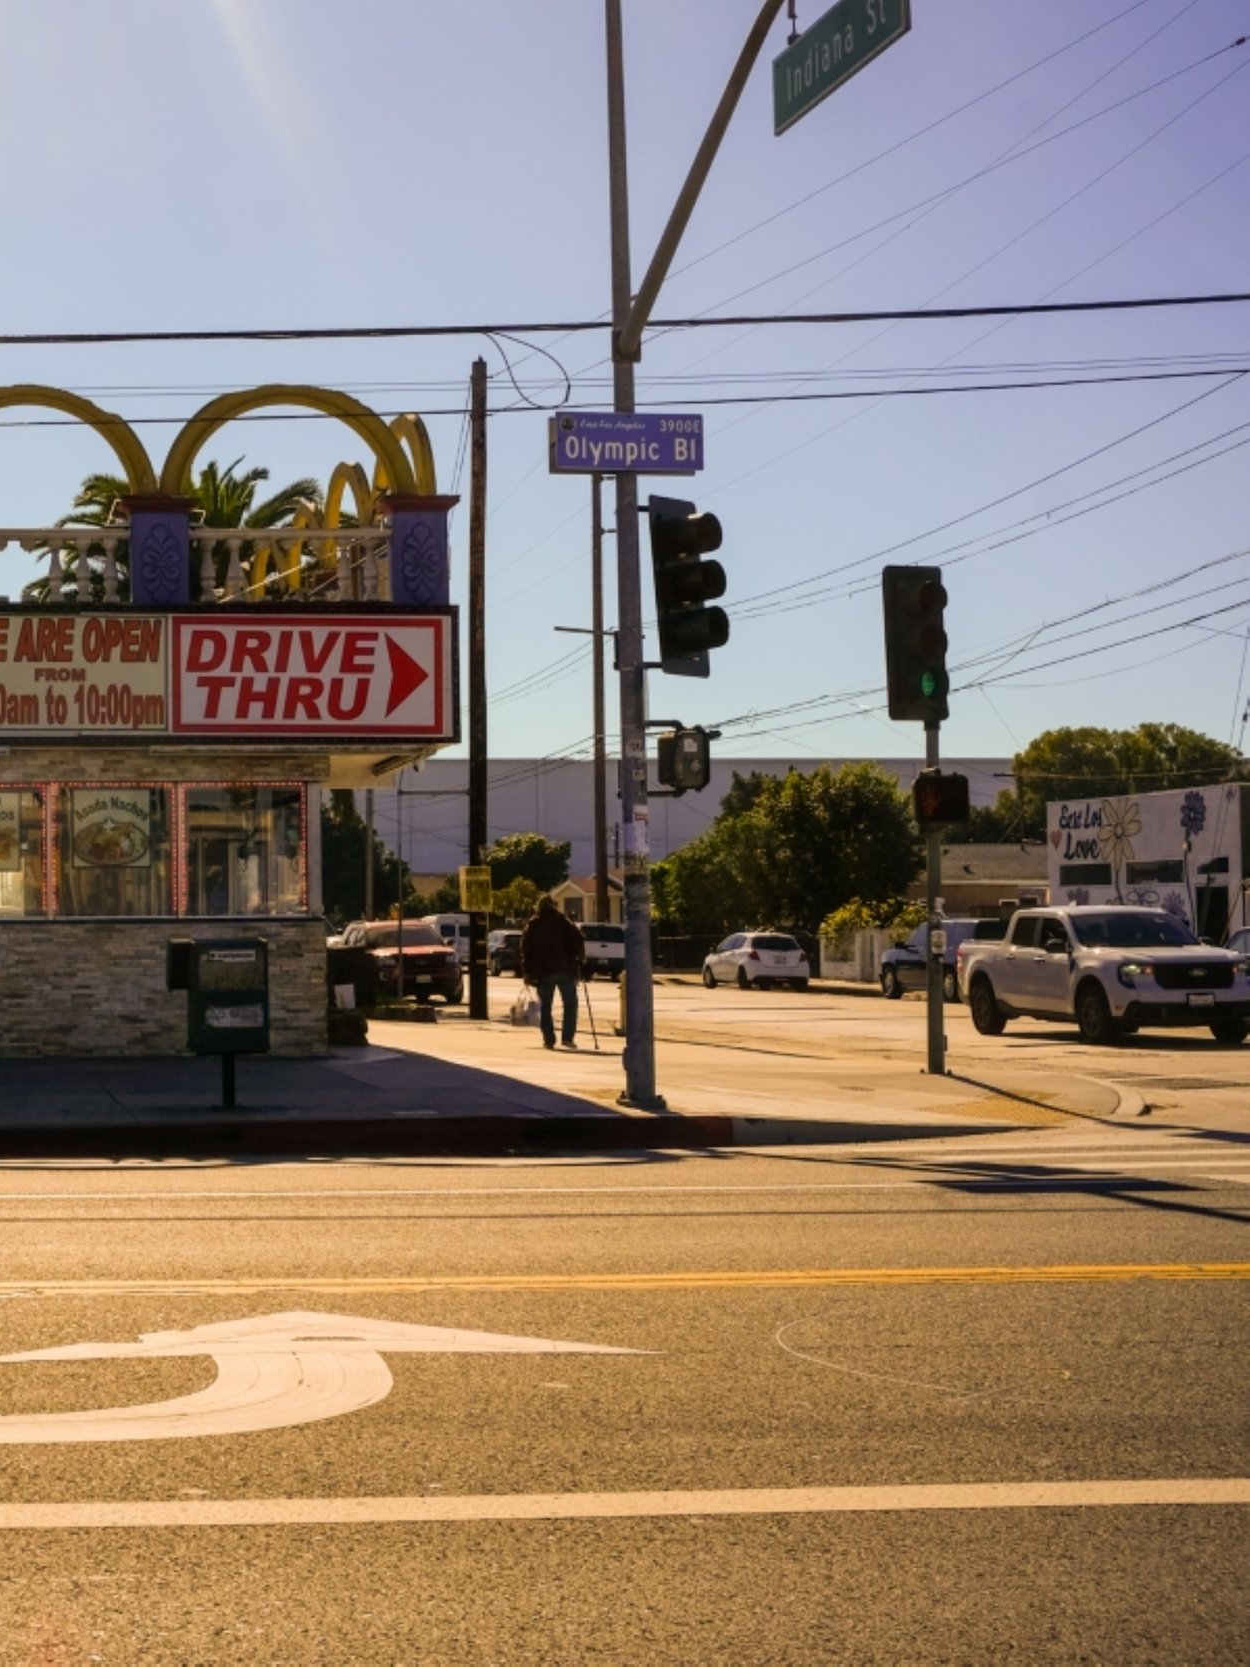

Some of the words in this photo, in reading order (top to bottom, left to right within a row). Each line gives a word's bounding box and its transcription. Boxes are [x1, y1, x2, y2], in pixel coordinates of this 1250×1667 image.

[786, 23, 854, 103] Indiana
[565, 436, 660, 466] Olympic
[674, 438, 696, 461] Bl
[14, 618, 75, 662] ARE
[82, 617, 162, 663] OPEN
[185, 630, 379, 673] DRIVE
[34, 668, 86, 682] FROM
[45, 686, 68, 725] to
[74, 684, 164, 729] 10:00pm
[196, 676, 370, 721] THRU
[76, 799, 108, 821] Asada
[111, 797, 149, 821] Nachos
[1063, 832, 1100, 860] Love
